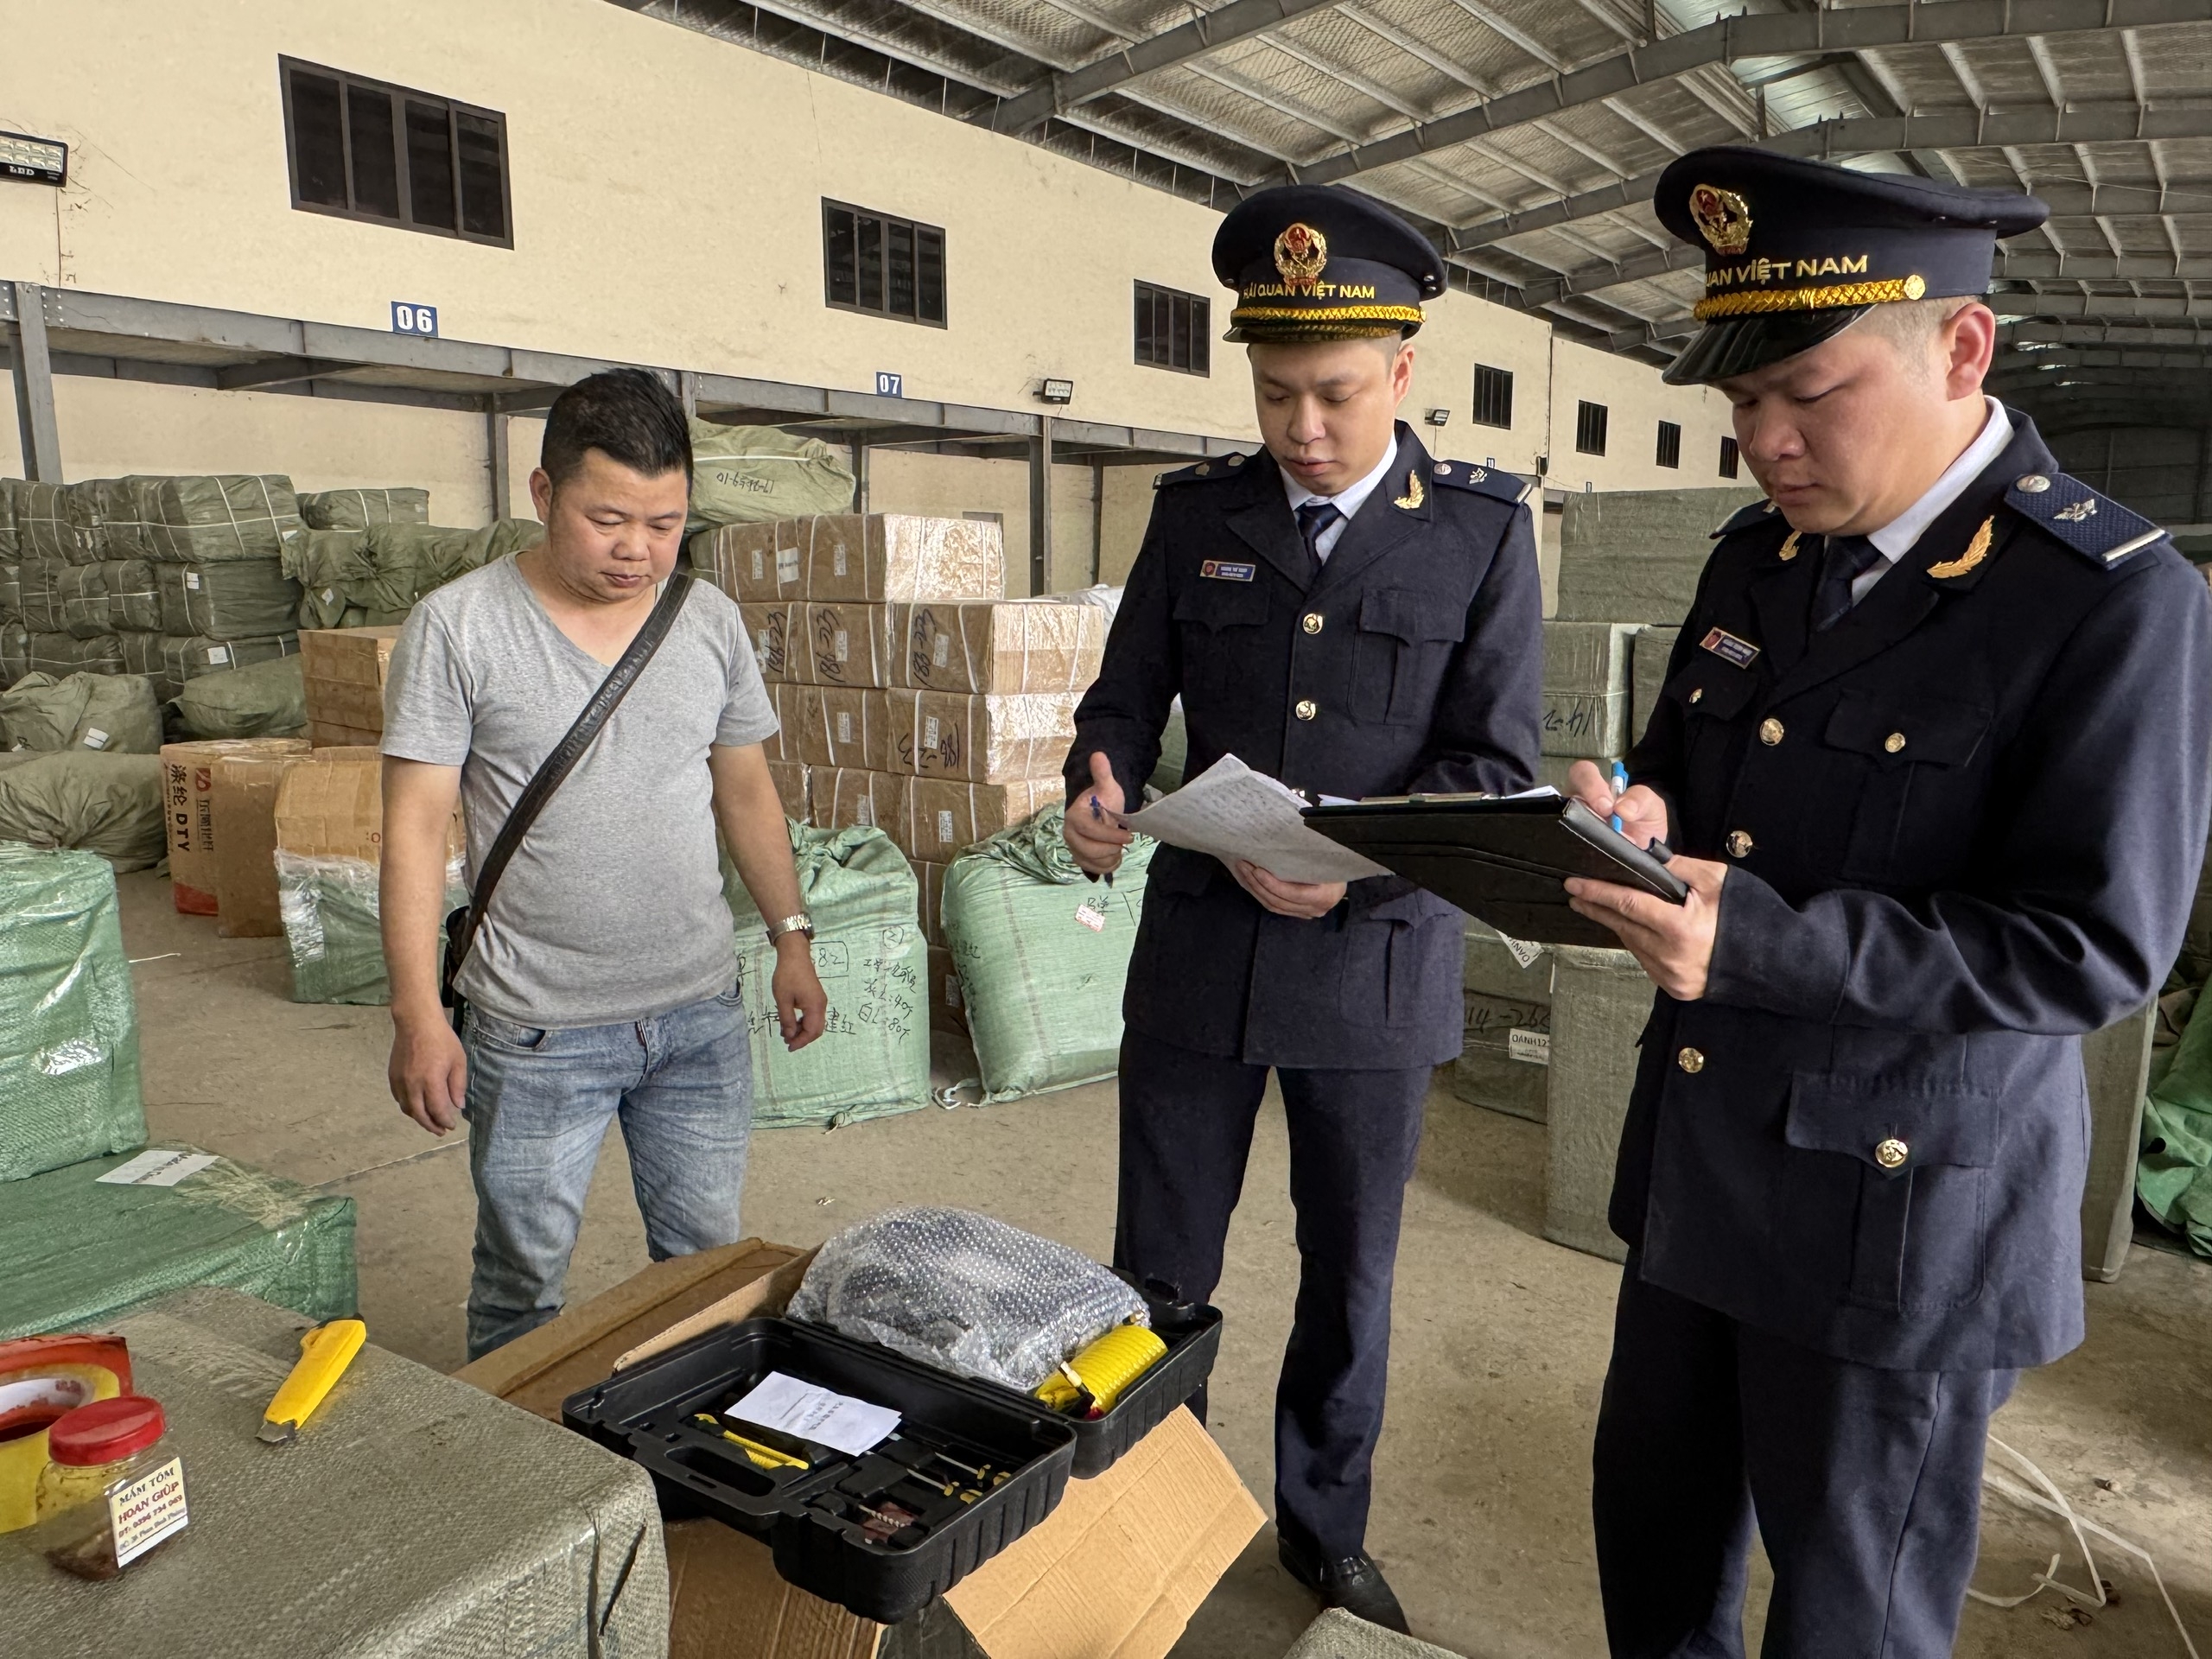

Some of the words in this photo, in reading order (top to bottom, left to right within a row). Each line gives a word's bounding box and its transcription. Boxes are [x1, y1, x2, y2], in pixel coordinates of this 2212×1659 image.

[1705, 267, 1733, 288] UAN
[1735, 257, 1792, 285] VIỆT
[1796, 254, 1868, 277] NAM
[1257, 283, 1296, 297] QUAN
[1300, 279, 1337, 300] VIỆT
[1339, 284, 1375, 299] NAM
[397, 305, 433, 333] 06
[880, 374, 900, 395] 07
[175, 813, 190, 852] DTY
[1512, 1034, 1550, 1047] OANH12
[149, 1467, 175, 1487] TÔM
[118, 1497, 149, 1524] HOAN
